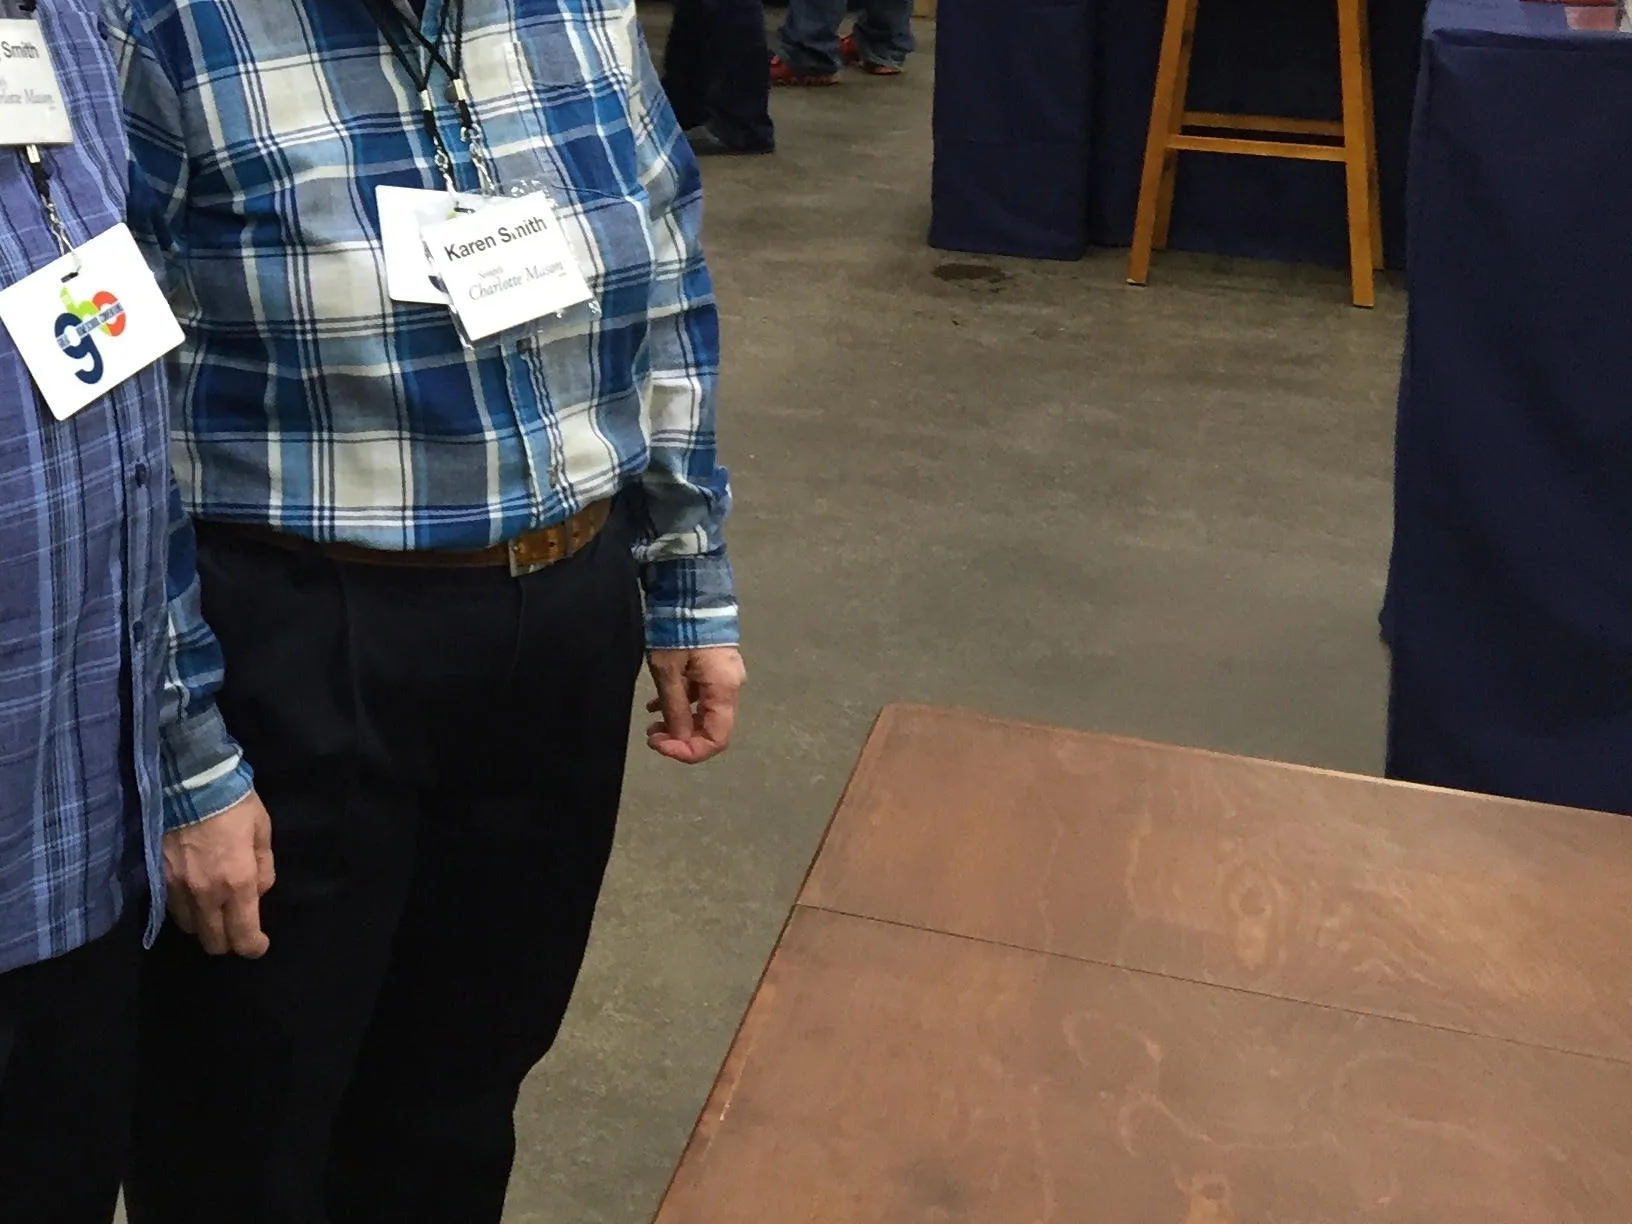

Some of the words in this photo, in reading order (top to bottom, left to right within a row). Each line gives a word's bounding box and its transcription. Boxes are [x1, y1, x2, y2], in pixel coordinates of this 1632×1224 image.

[1, 40, 41, 60] Smith
[444, 235, 497, 261] Karen
[468, 276, 523, 301] Charlotte
